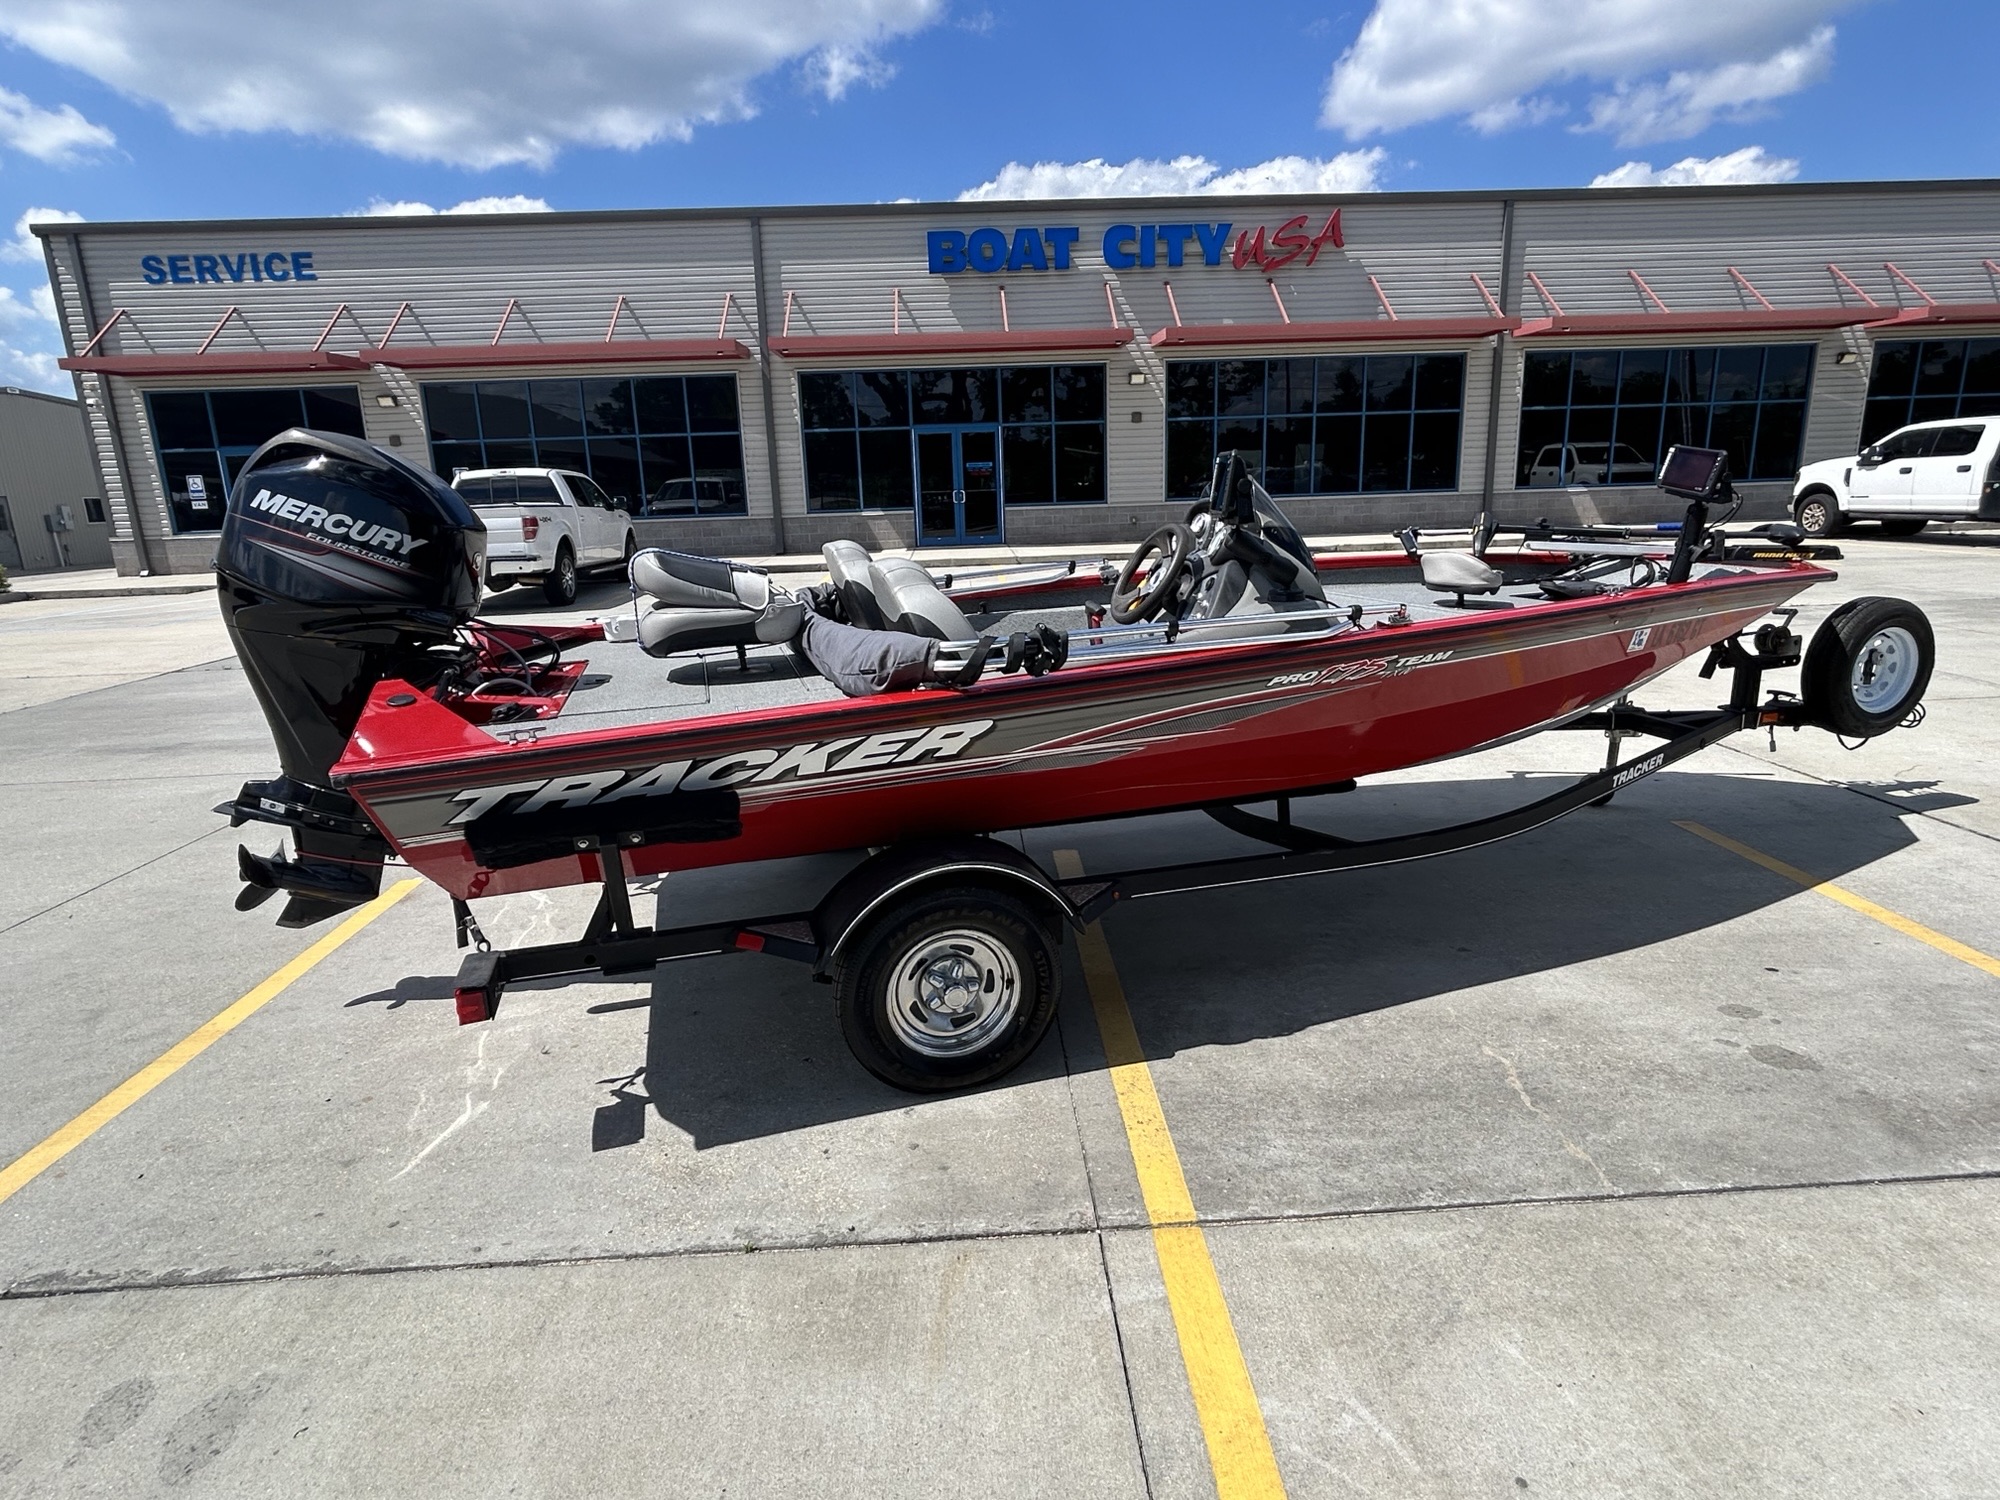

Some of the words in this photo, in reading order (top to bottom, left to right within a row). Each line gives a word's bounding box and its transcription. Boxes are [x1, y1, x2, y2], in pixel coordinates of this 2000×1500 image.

[926, 226, 1080, 274] BOAT
[1102, 223, 1233, 269] CITY
[1232, 208, 1345, 273] USA
[141, 251, 318, 285] SERVICE
[250, 488, 429, 555] MERCURY
[305, 532, 412, 569] FOURSTROKE
[1267, 671, 1319, 687] PRO
[1396, 650, 1454, 668] TEAM
[446, 719, 995, 826] TRACKER
[1612, 753, 1665, 788] TRACKER
